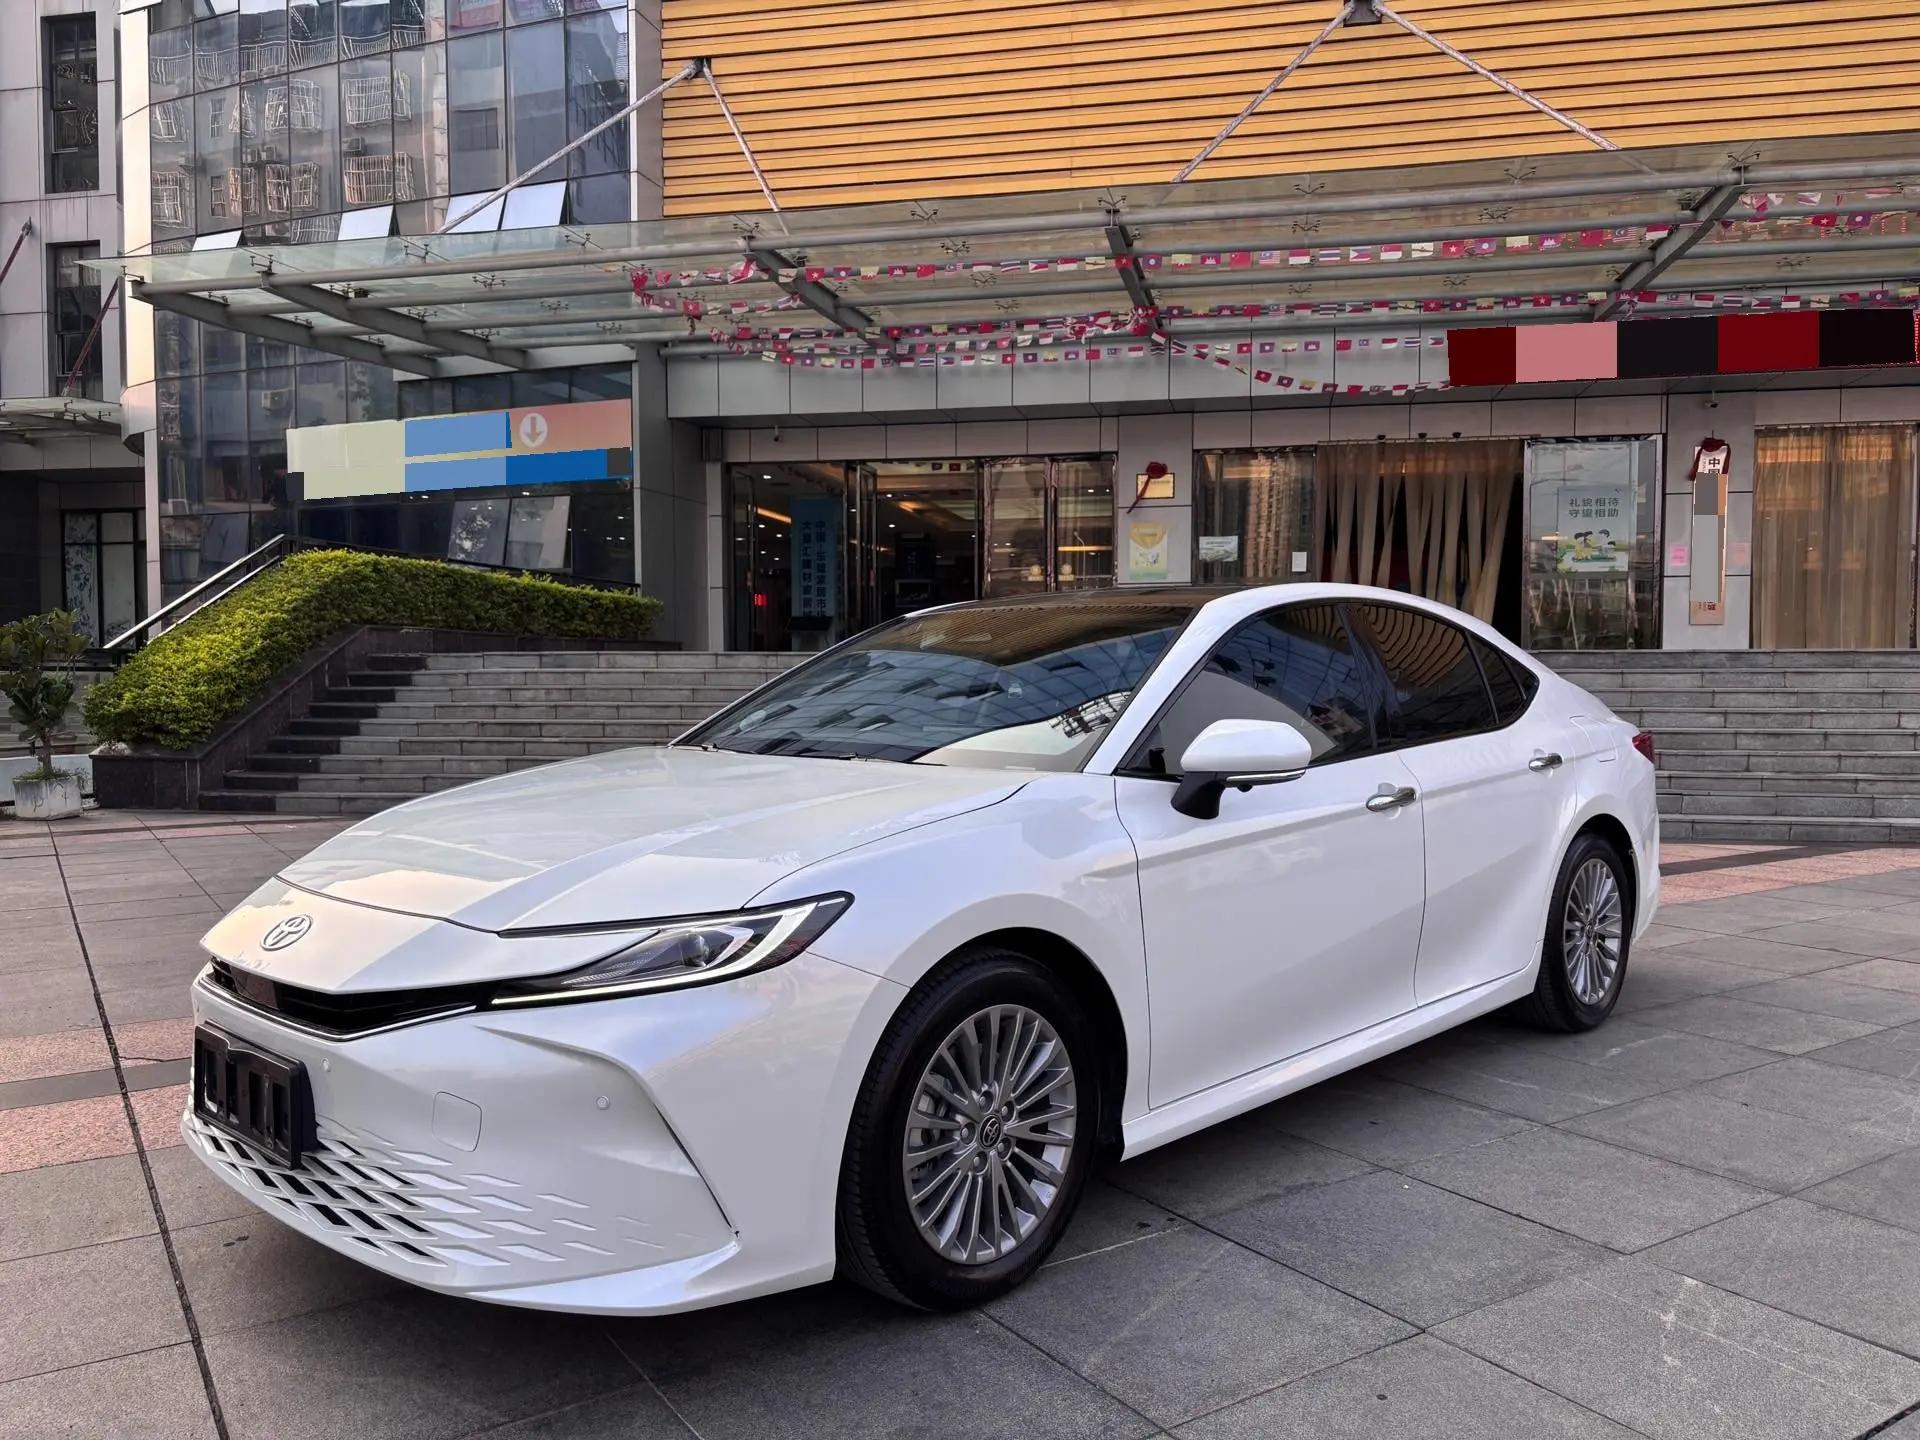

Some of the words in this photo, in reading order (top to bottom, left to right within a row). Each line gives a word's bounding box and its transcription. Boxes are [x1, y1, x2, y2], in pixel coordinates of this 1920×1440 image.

[1568, 497, 1619, 508] 礼貌相待
[1568, 508, 1619, 518] 守望相助
